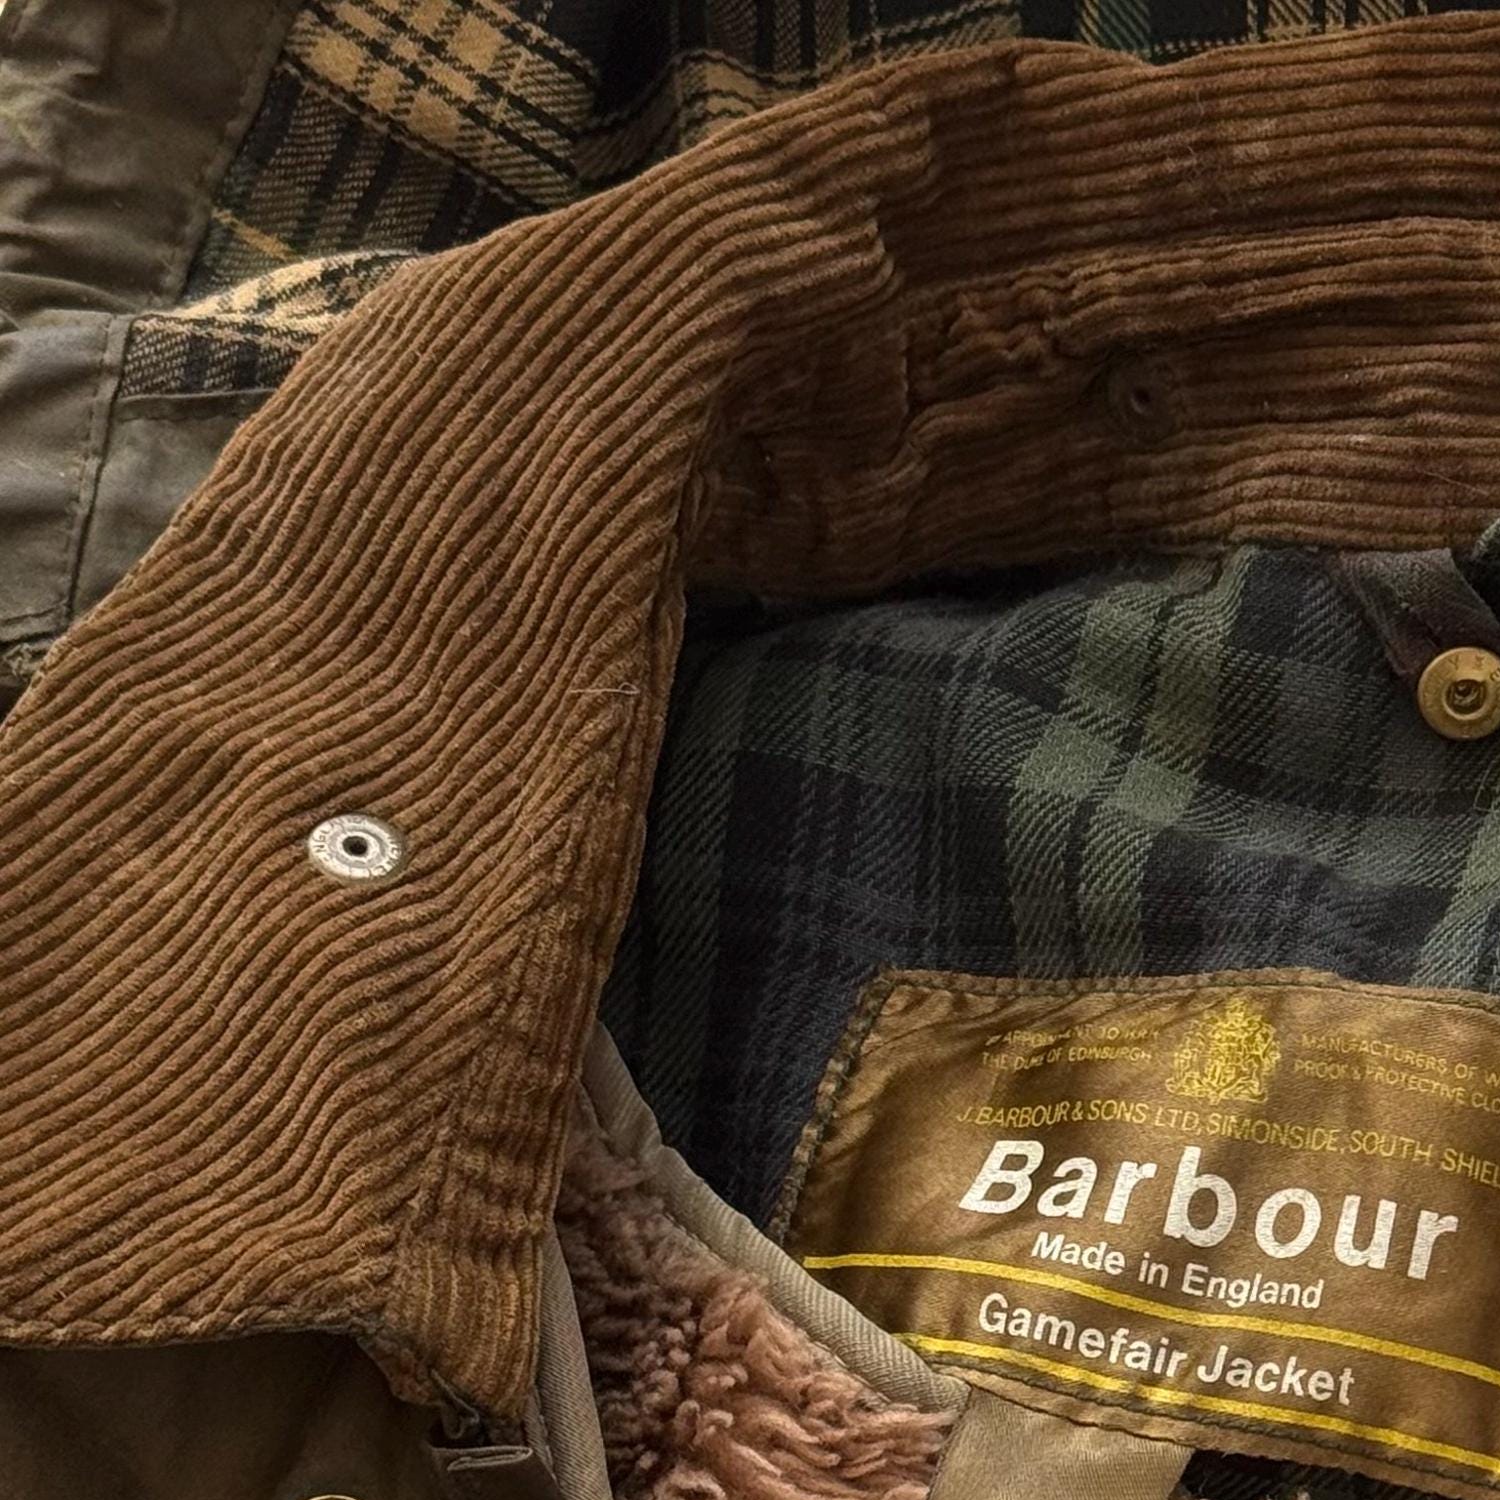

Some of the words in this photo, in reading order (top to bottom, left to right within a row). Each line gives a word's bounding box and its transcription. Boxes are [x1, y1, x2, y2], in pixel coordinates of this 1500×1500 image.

[982, 1051, 1009, 1071] THE
[1301, 1033, 1448, 1076] MANUFACTURERS
[1454, 1062, 1478, 1081] OF
[1365, 1064, 1466, 1104] PROTECTIVE
[1087, 1099, 1149, 1125] SONS
[1349, 1129, 1434, 1166] SOUTH
[958, 1139, 1459, 1281] Barbour
[1030, 1231, 1127, 1276] Made
[1138, 1251, 1169, 1288] in
[1180, 1263, 1325, 1310] England
[977, 1292, 1189, 1379] Gamefair
[1196, 1343, 1356, 1406] Jacket
